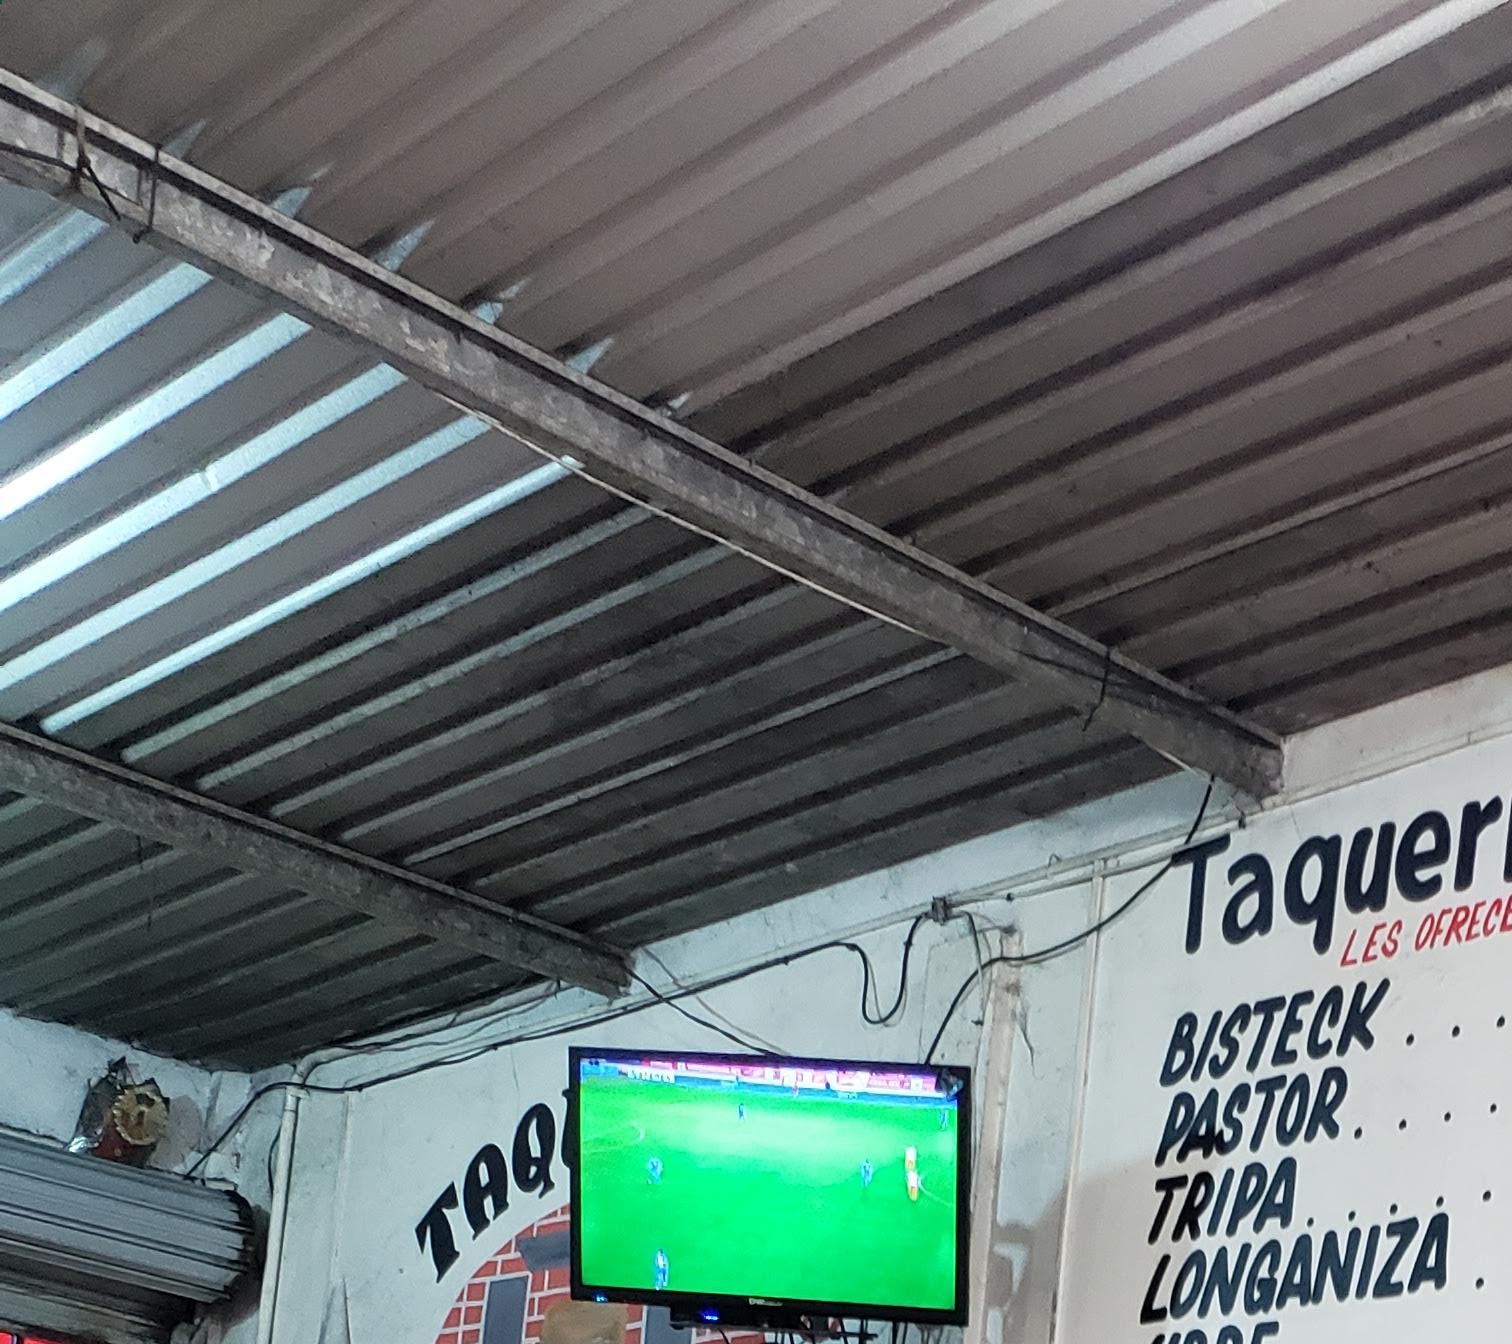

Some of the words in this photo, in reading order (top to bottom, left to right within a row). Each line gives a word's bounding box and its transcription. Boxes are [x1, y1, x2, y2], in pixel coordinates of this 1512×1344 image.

[1340, 924, 1402, 967] LES
[1159, 977, 1391, 1088] BISTECK
[1154, 1066, 1348, 1168] PASTOR
[1147, 1156, 1297, 1246] TRIPA
[1139, 1212, 1449, 1325] LONGANIZA
